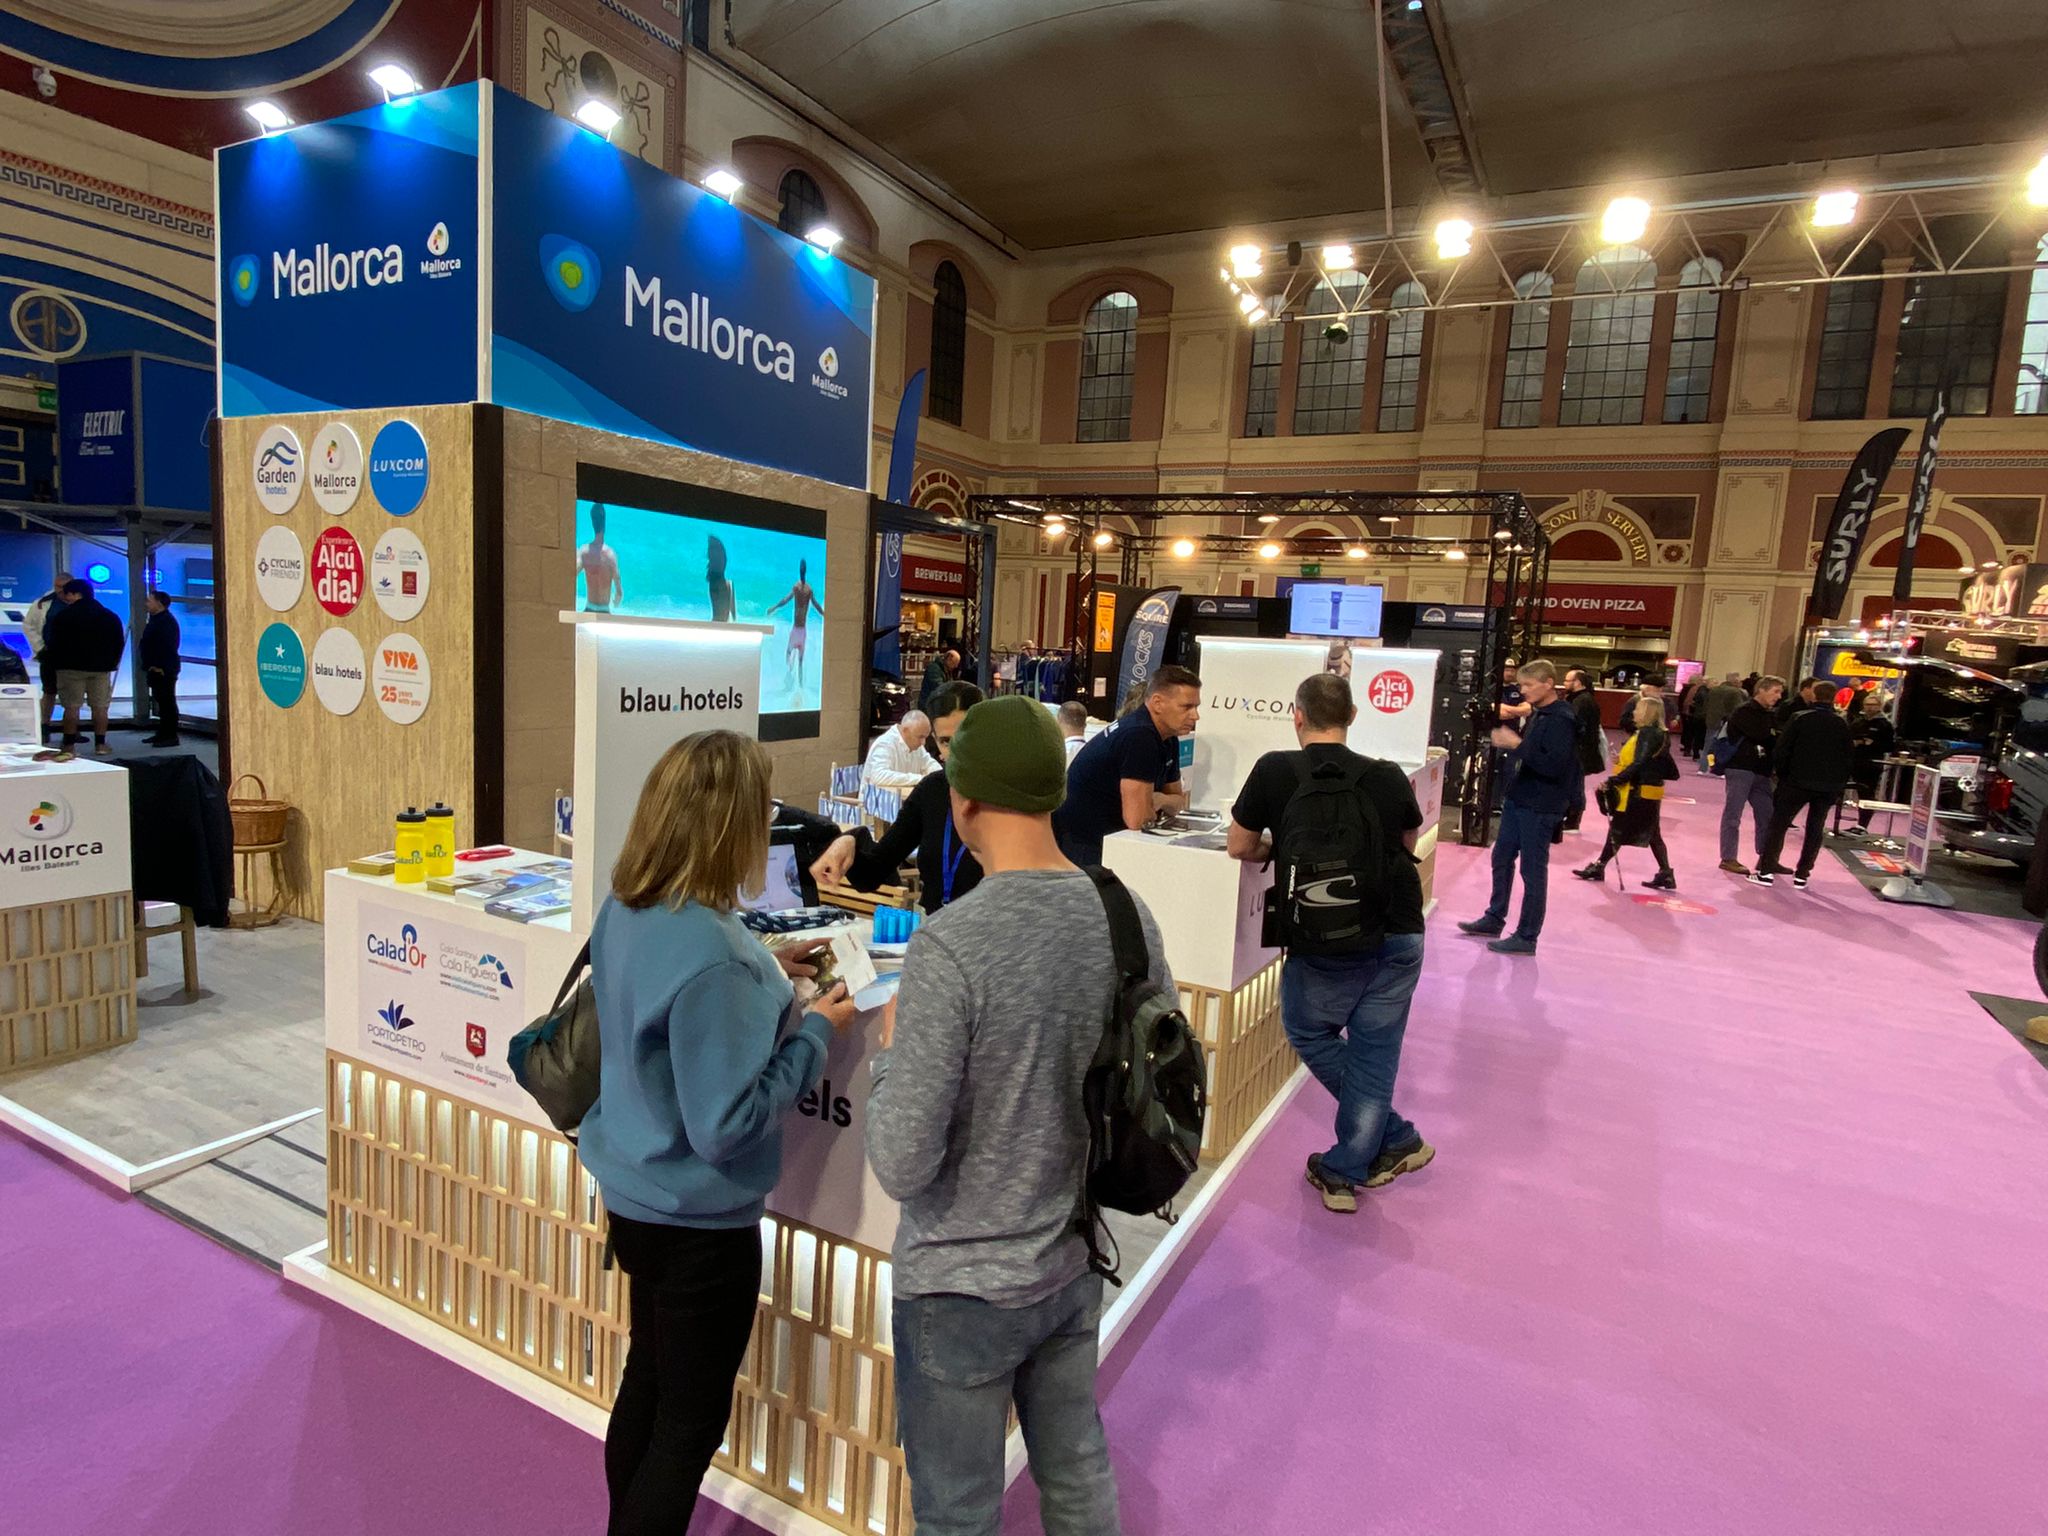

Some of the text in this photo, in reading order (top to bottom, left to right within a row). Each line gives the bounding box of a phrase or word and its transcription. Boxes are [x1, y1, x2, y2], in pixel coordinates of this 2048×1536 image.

[273, 243, 403, 299] Mallorca
[420, 257, 461, 274] Mallorca
[624, 265, 795, 383] Mallorca
[811, 373, 848, 398] Mallorca
[83, 409, 126, 438] ELECTRIC
[373, 458, 424, 473] LUXCOM
[257, 467, 296, 483] Garden
[314, 474, 357, 488] Mallorca
[265, 485, 288, 495] hotels
[1826, 468, 1878, 584] SURLY
[1606, 511, 1649, 562] SERVERY
[270, 558, 300, 570] CYCLING
[317, 545, 355, 570] Alcú
[270, 571, 300, 580] FRIENDLY
[915, 567, 962, 584] BREWER'S BAR
[317, 569, 357, 604] dia!
[1561, 598, 1600, 609] OVEN
[1604, 599, 1646, 612] PIZZA
[1962, 578, 2018, 616] SURLY
[1135, 610, 1169, 624] SQUIRE
[260, 662, 302, 674] IBEROSTAR
[383, 650, 418, 670] VIVA
[315, 663, 362, 680] blau hotels
[1374, 677, 1408, 692] Alcú
[381, 685, 397, 703] 25
[1372, 691, 1408, 709] dia!
[0, 841, 103, 865] Mallorca
[44, 859, 80, 870] Balears
[440, 954, 498, 983] Cala Figuera
[367, 1023, 426, 1053] PORTOPETRO
